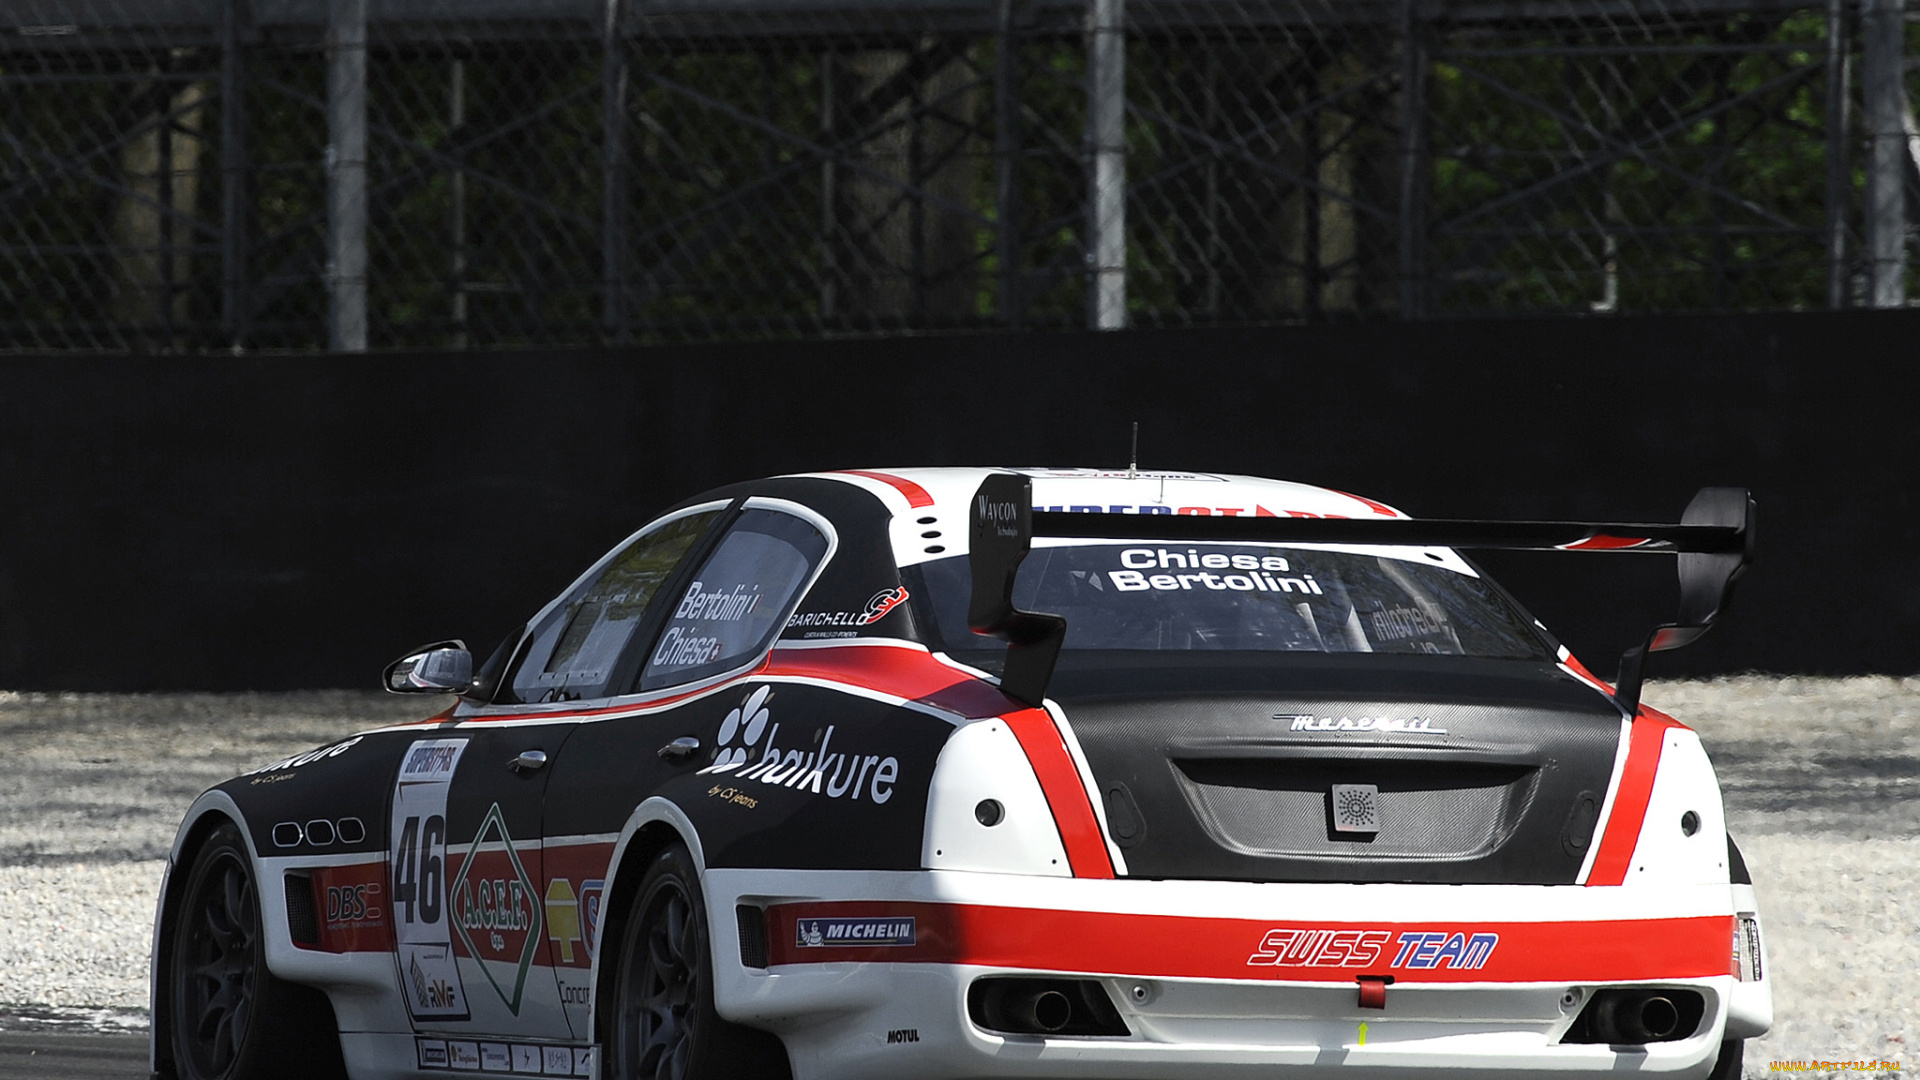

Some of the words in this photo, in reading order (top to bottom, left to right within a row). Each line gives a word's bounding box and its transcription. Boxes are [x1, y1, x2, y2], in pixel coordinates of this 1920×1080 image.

[1119, 547, 1290, 573] Chiesa
[675, 581, 758, 621] Bertolini
[1108, 569, 1323, 595] Bertolini
[653, 626, 717, 666] Chiesa
[735, 722, 898, 804] haikure
[394, 814, 446, 924] 46
[826, 923, 911, 938] MICHELIN
[1247, 928, 1391, 968] SWISS
[1390, 932, 1499, 969] TEAM
[887, 1029, 920, 1044] MOTUL
